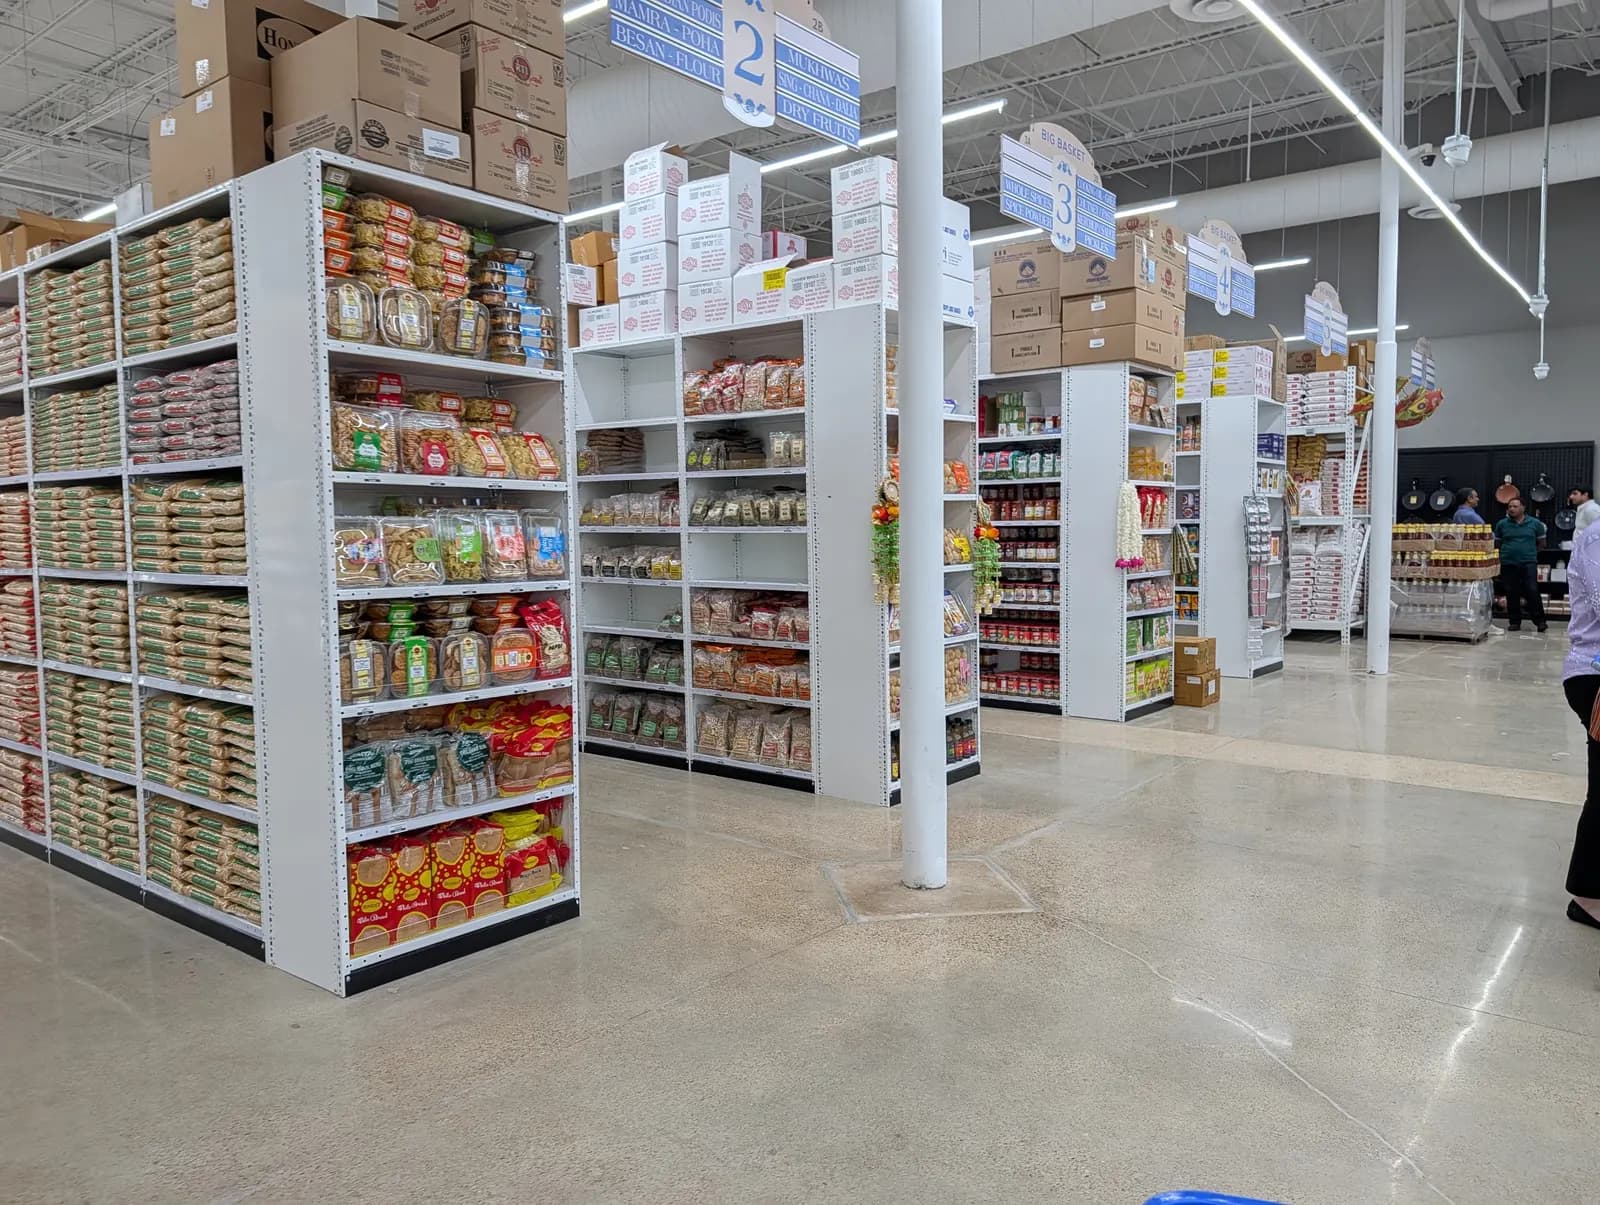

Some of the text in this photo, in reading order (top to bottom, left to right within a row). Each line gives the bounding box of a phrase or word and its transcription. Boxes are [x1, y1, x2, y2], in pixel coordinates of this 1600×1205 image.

[615, 0, 671, 33] MAMRA
[682, 24, 720, 57] POHA
[692, 1, 721, 29] PODIS
[812, 18, 824, 33] 2B
[616, 23, 665, 58] BESAN
[676, 51, 721, 84] FLOUR
[733, 20, 765, 86] 2
[788, 49, 850, 91] MUKHWAS
[783, 99, 855, 141] DRY FRUITS
[1041, 128, 1086, 161] BIG BASKET
[1057, 183, 1072, 224] 3
[1218, 265, 1229, 295] 4
